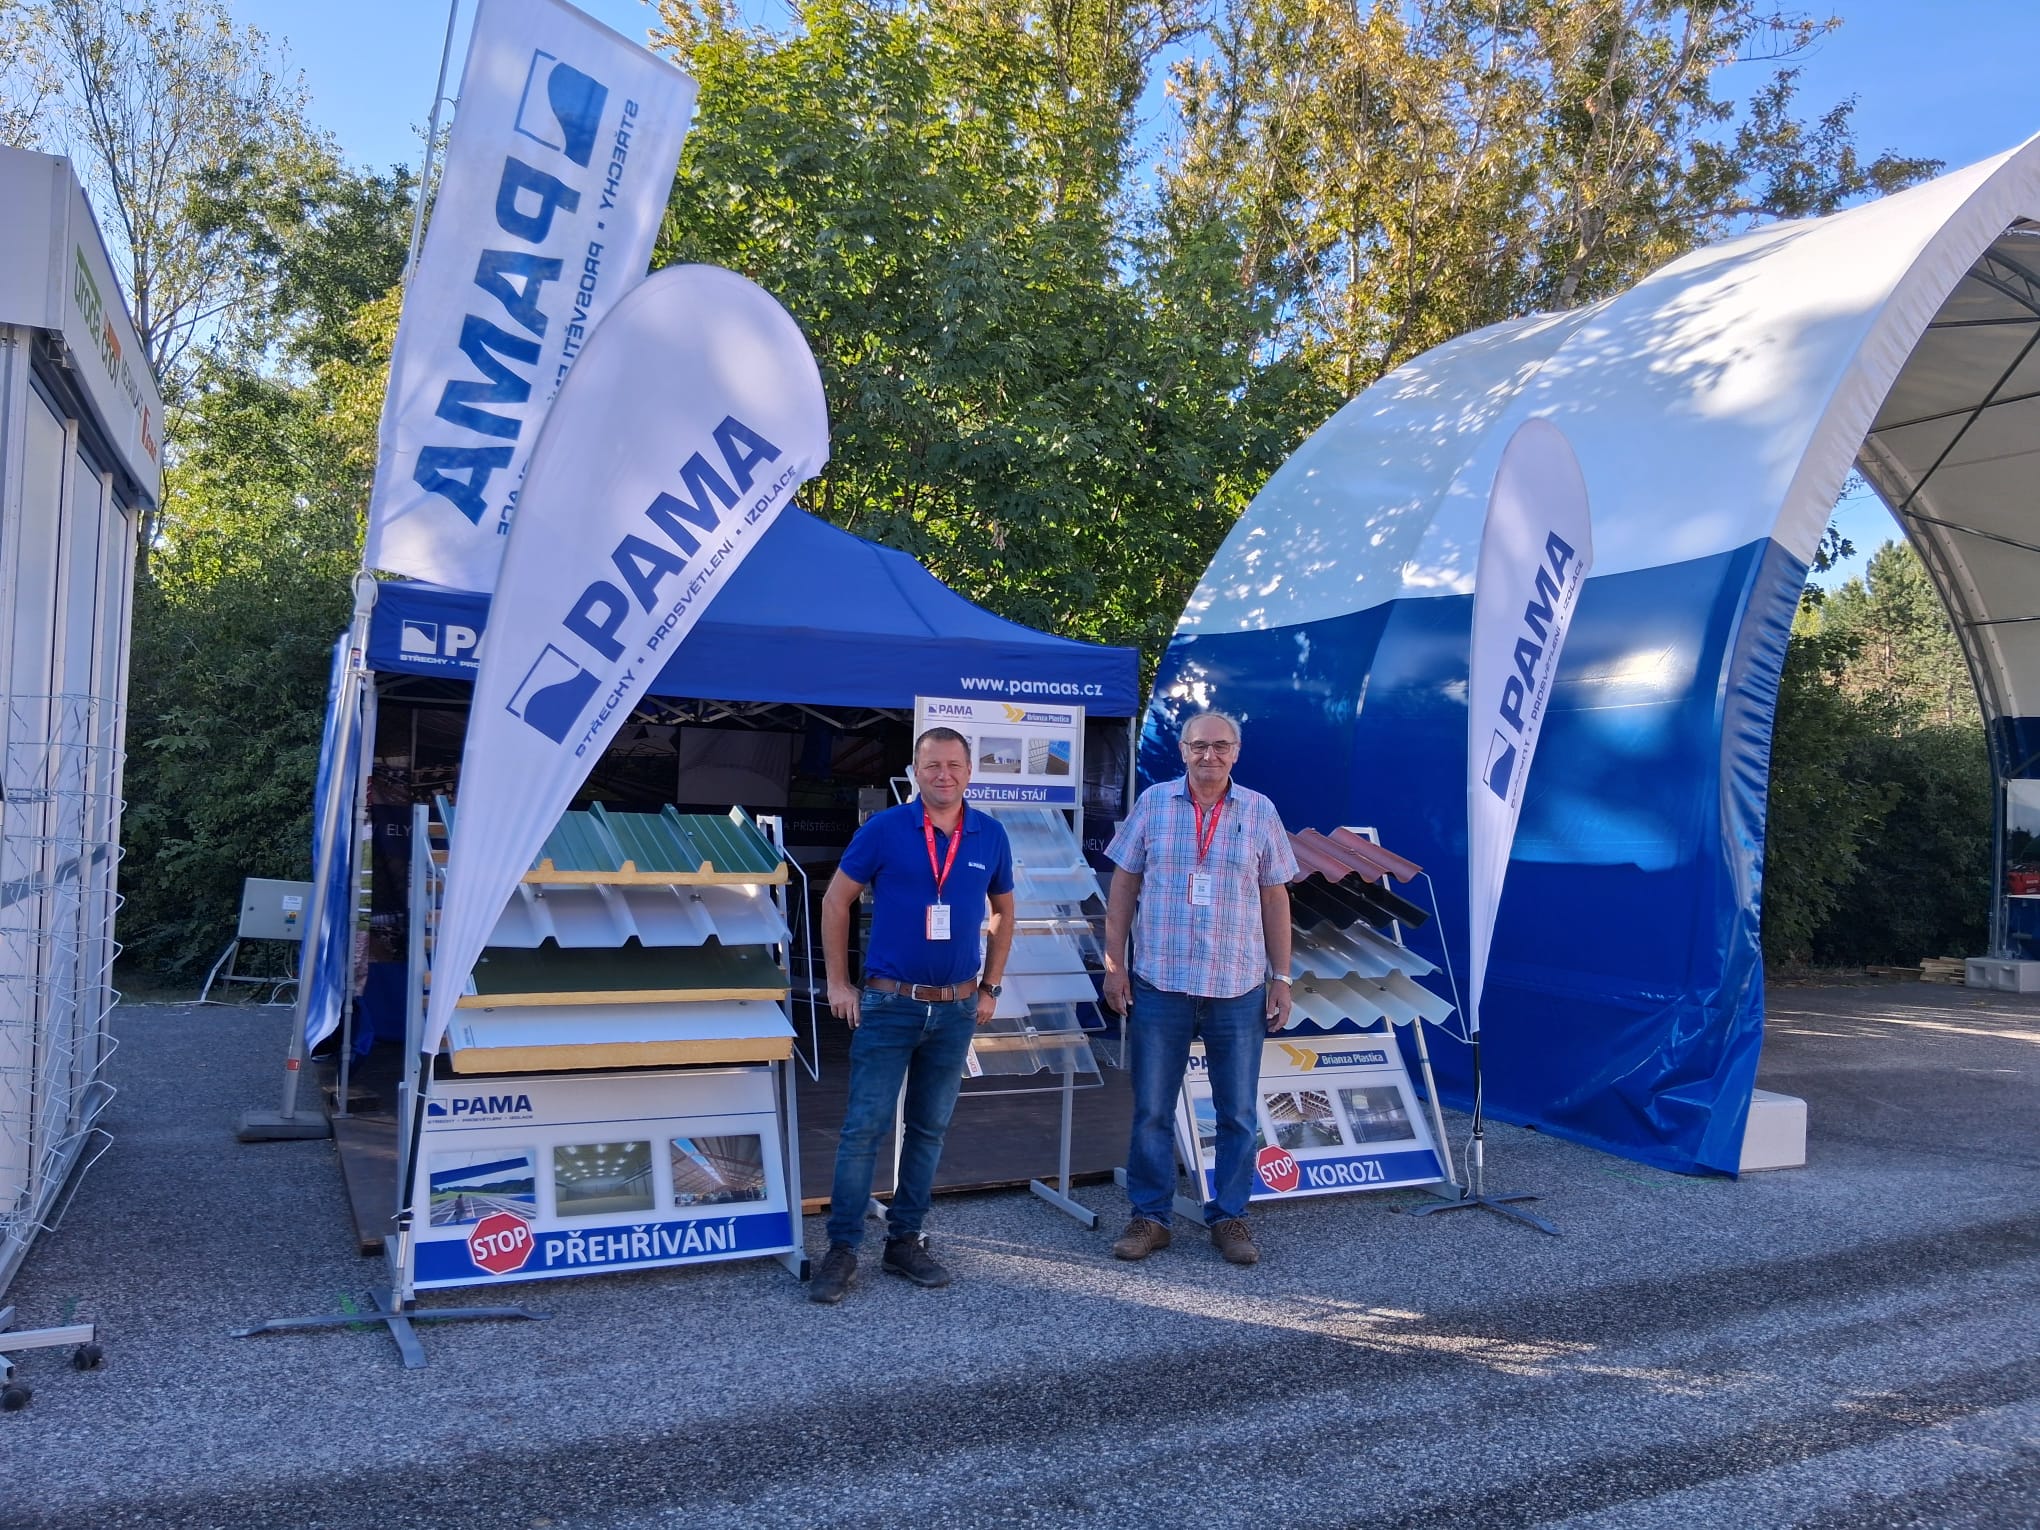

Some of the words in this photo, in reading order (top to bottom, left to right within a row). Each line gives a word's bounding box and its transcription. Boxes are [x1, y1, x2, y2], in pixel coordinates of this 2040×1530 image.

[563, 415, 783, 663] PAMA
[575, 670, 638, 758] STŘECHY
[647, 536, 736, 652] PROSVĚTLENÍ
[743, 465, 797, 527] IZOLACE
[1500, 530, 1576, 735] PAMA
[960, 677, 1104, 696] www.pamaas.cz
[938, 704, 973, 716] PAMA
[1021, 788, 1048, 801] STÁJÍ
[1321, 1052, 1352, 1066] Brianza
[1353, 1050, 1385, 1064] Plastica
[453, 1094, 533, 1116] PAMA
[1261, 1156, 1294, 1183] STOP
[1307, 1160, 1385, 1187] KOROZI
[473, 1227, 529, 1262] STOP
[545, 1218, 737, 1266] PŘEHŘÍVÁNÍ
